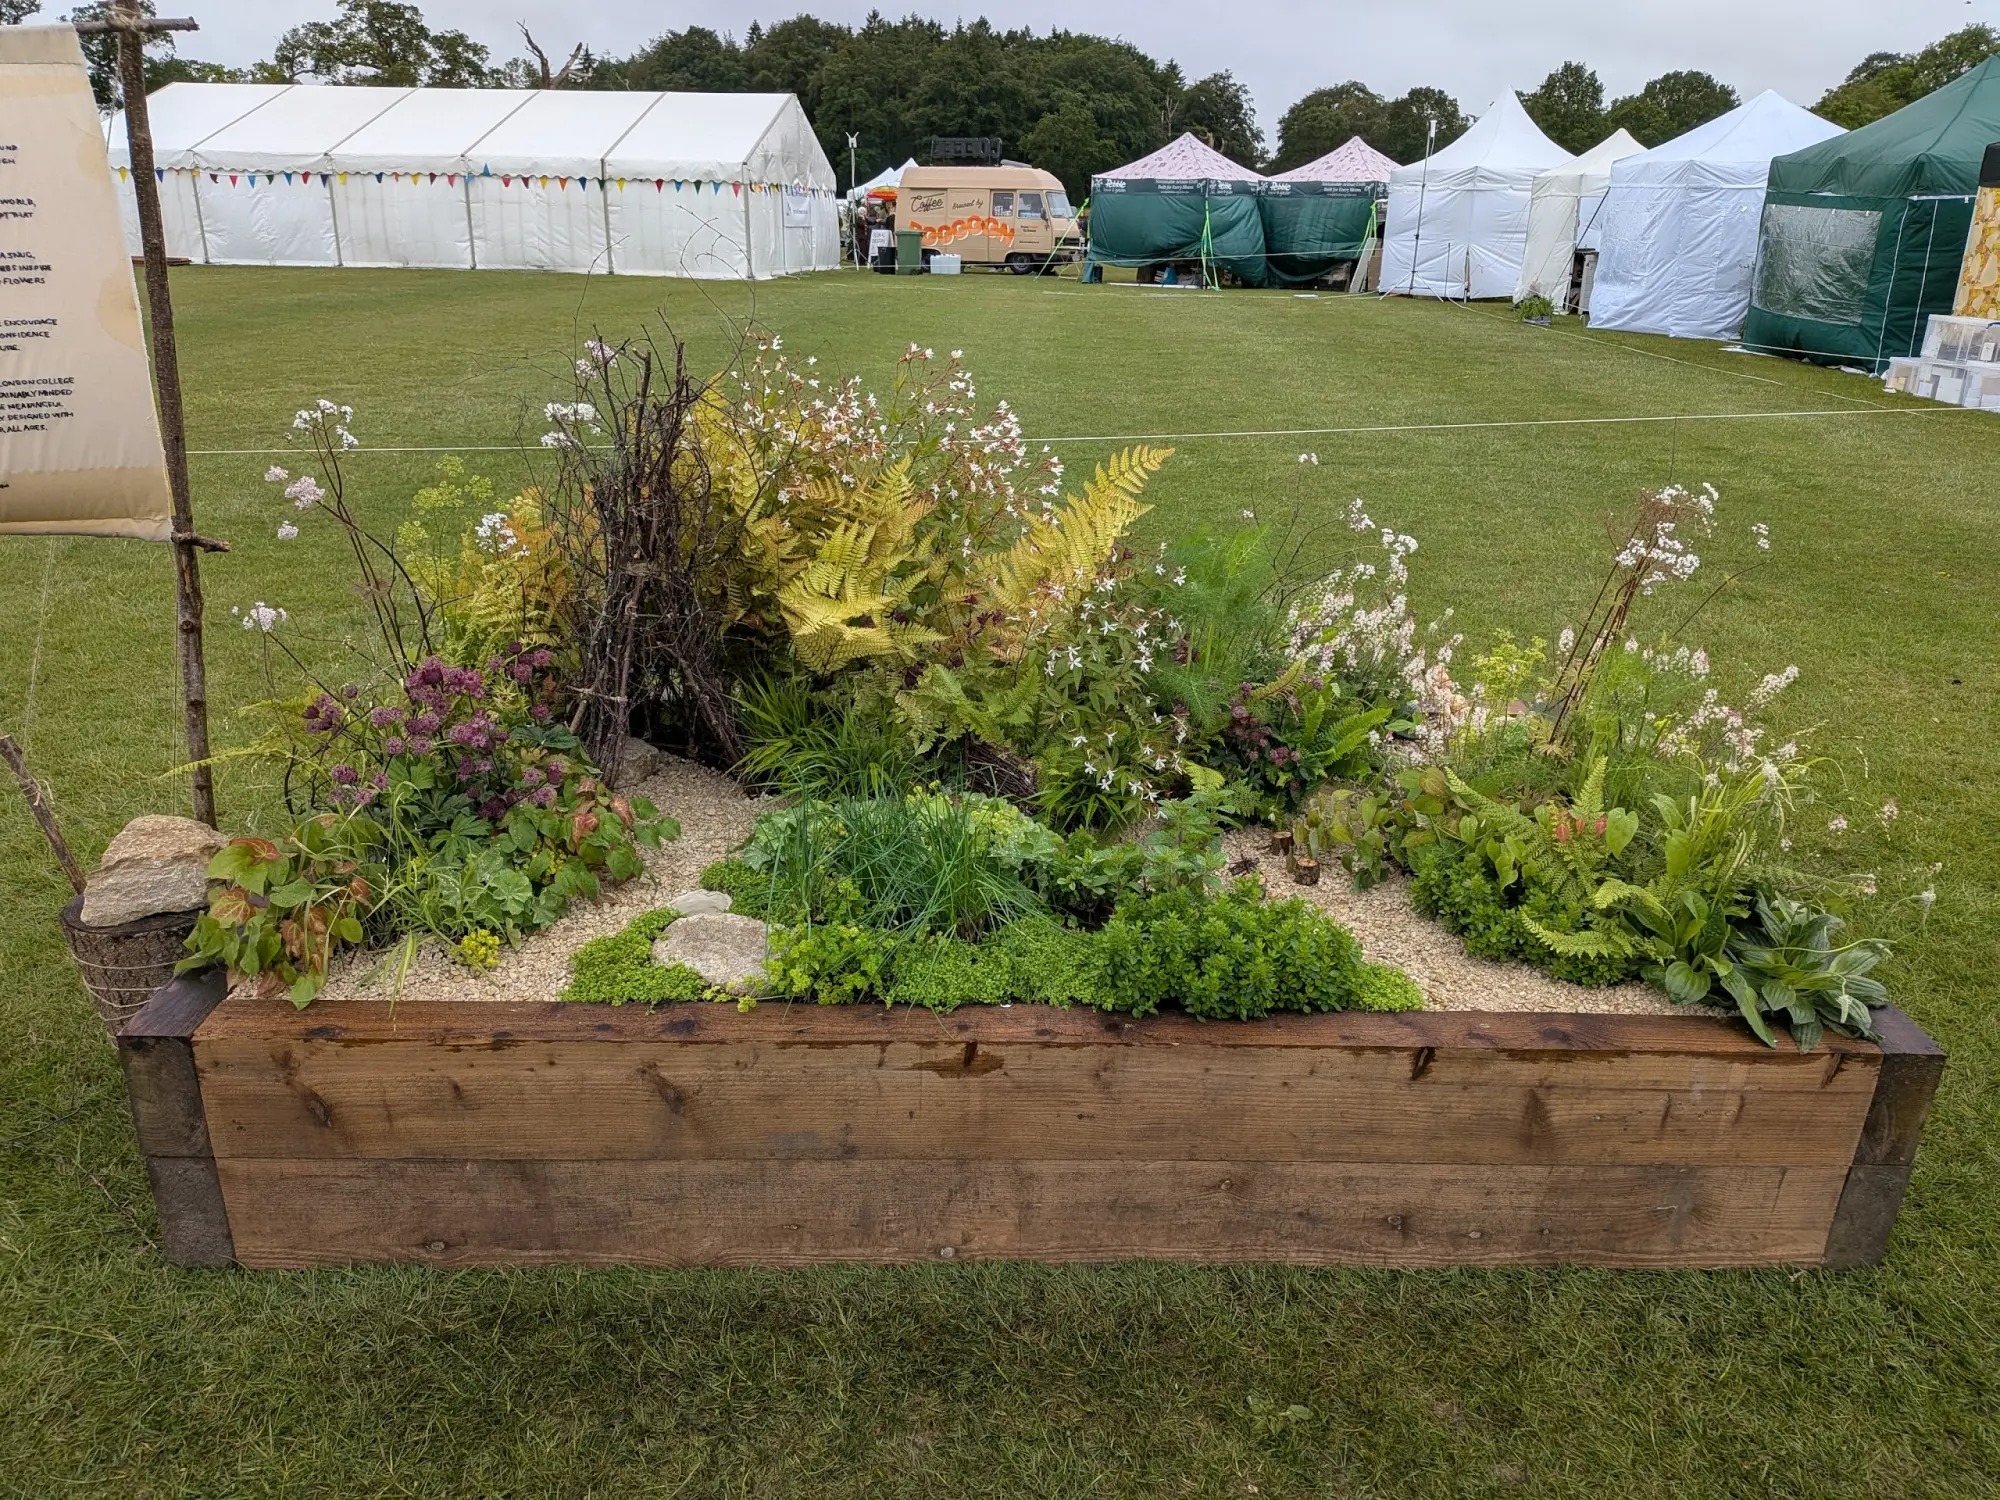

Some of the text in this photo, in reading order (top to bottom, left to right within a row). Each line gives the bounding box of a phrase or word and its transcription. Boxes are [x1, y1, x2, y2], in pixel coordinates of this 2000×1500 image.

[910, 194, 984, 213] Coffee brewed by
[3, 277, 46, 286] FLOWERS
[4, 318, 58, 327] ENCOURAGE
[0, 377, 75, 387] ONDON COLLEGE
[38, 389, 73, 397] MINDED
[7, 401, 64, 411] MEANINGFUL
[8, 412, 50, 421] DESIGNED
[52, 411, 74, 419] WITH
[7, 424, 22, 433] ALL
